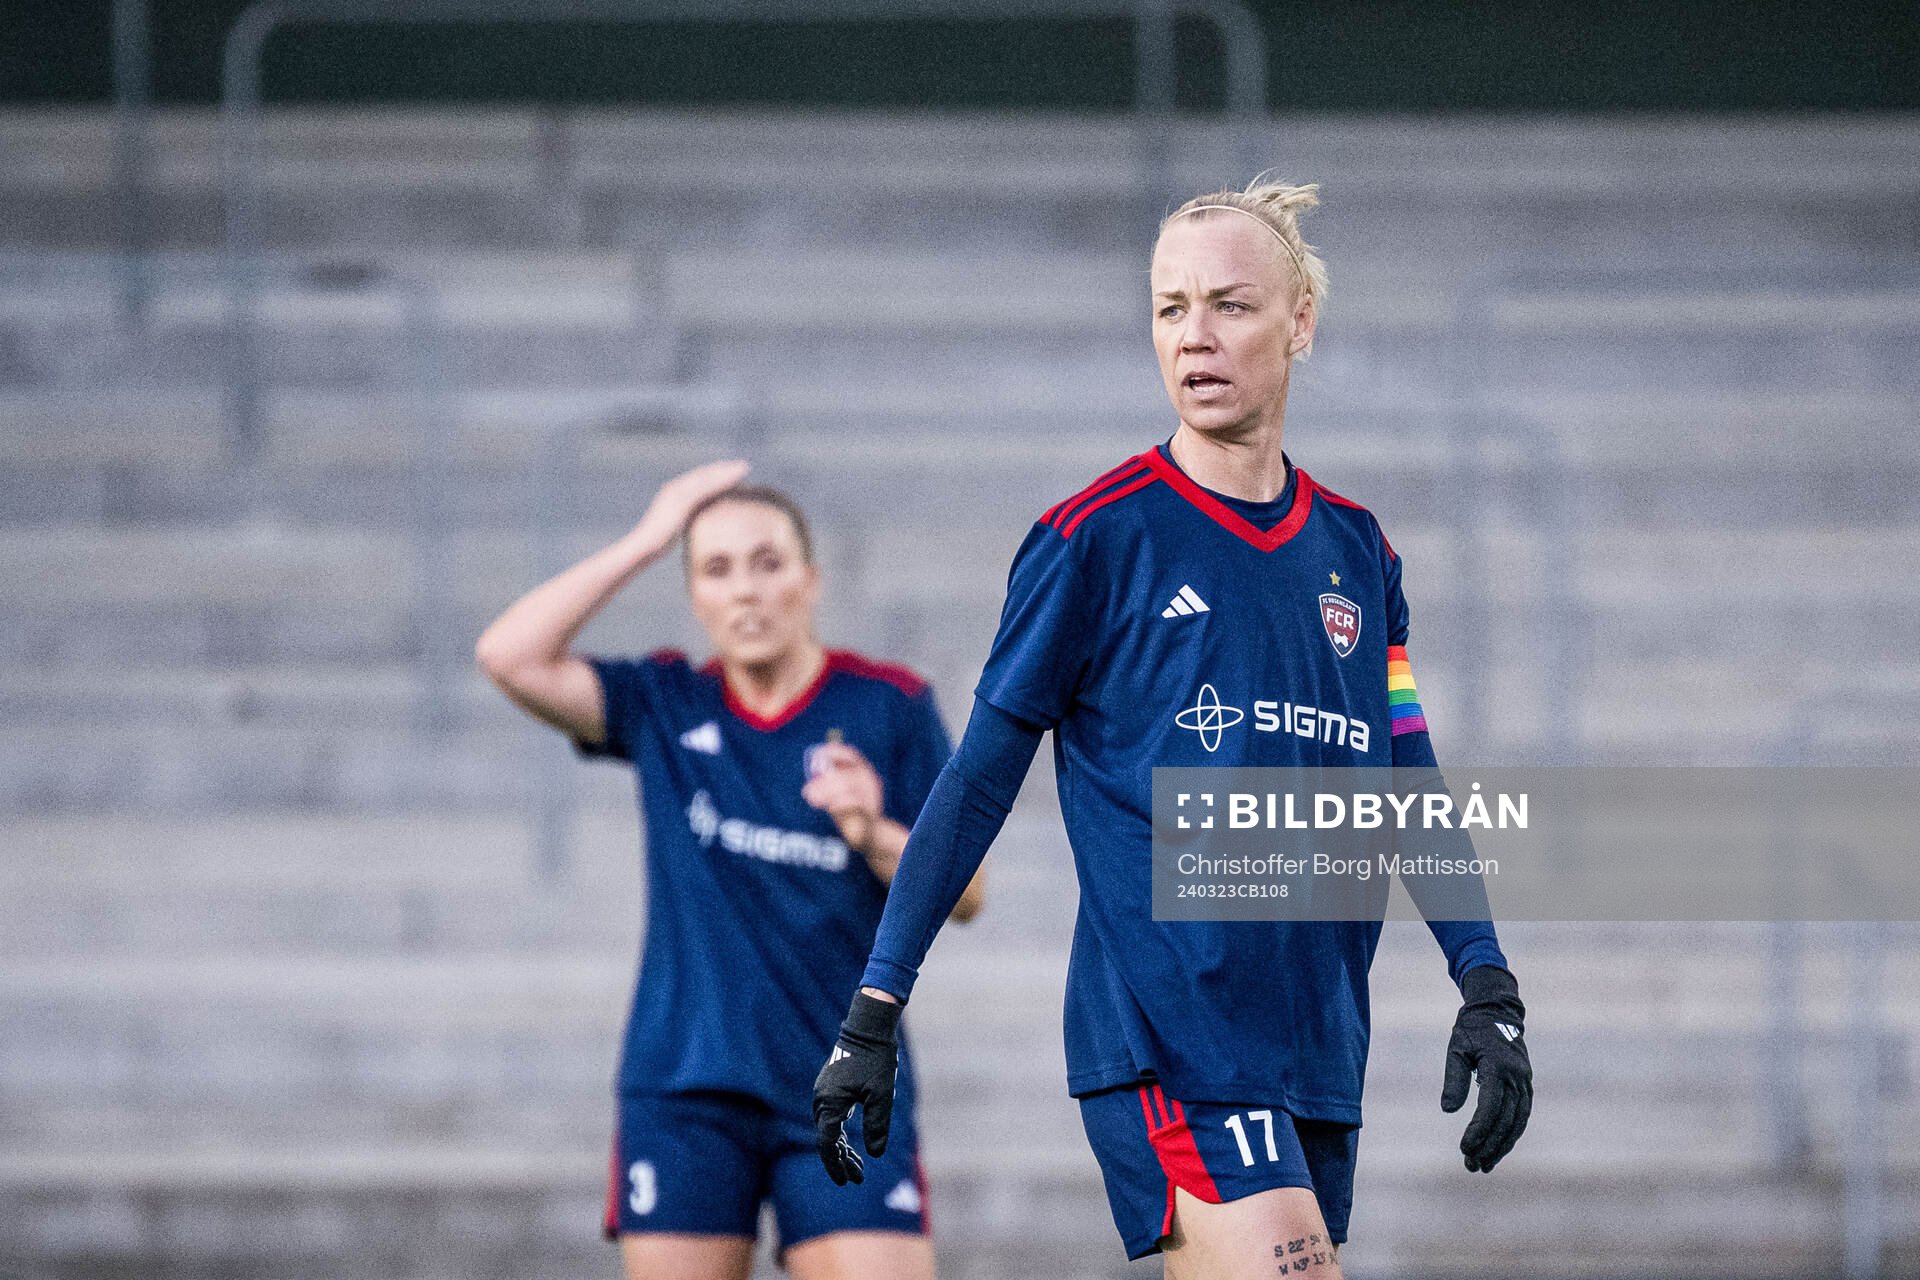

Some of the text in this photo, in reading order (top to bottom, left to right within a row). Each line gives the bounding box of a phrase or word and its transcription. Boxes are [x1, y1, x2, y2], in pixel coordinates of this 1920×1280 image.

[1326, 607, 1354, 630] FCR
[1224, 1109, 1280, 1168] 17
[628, 1159, 657, 1216] 3
